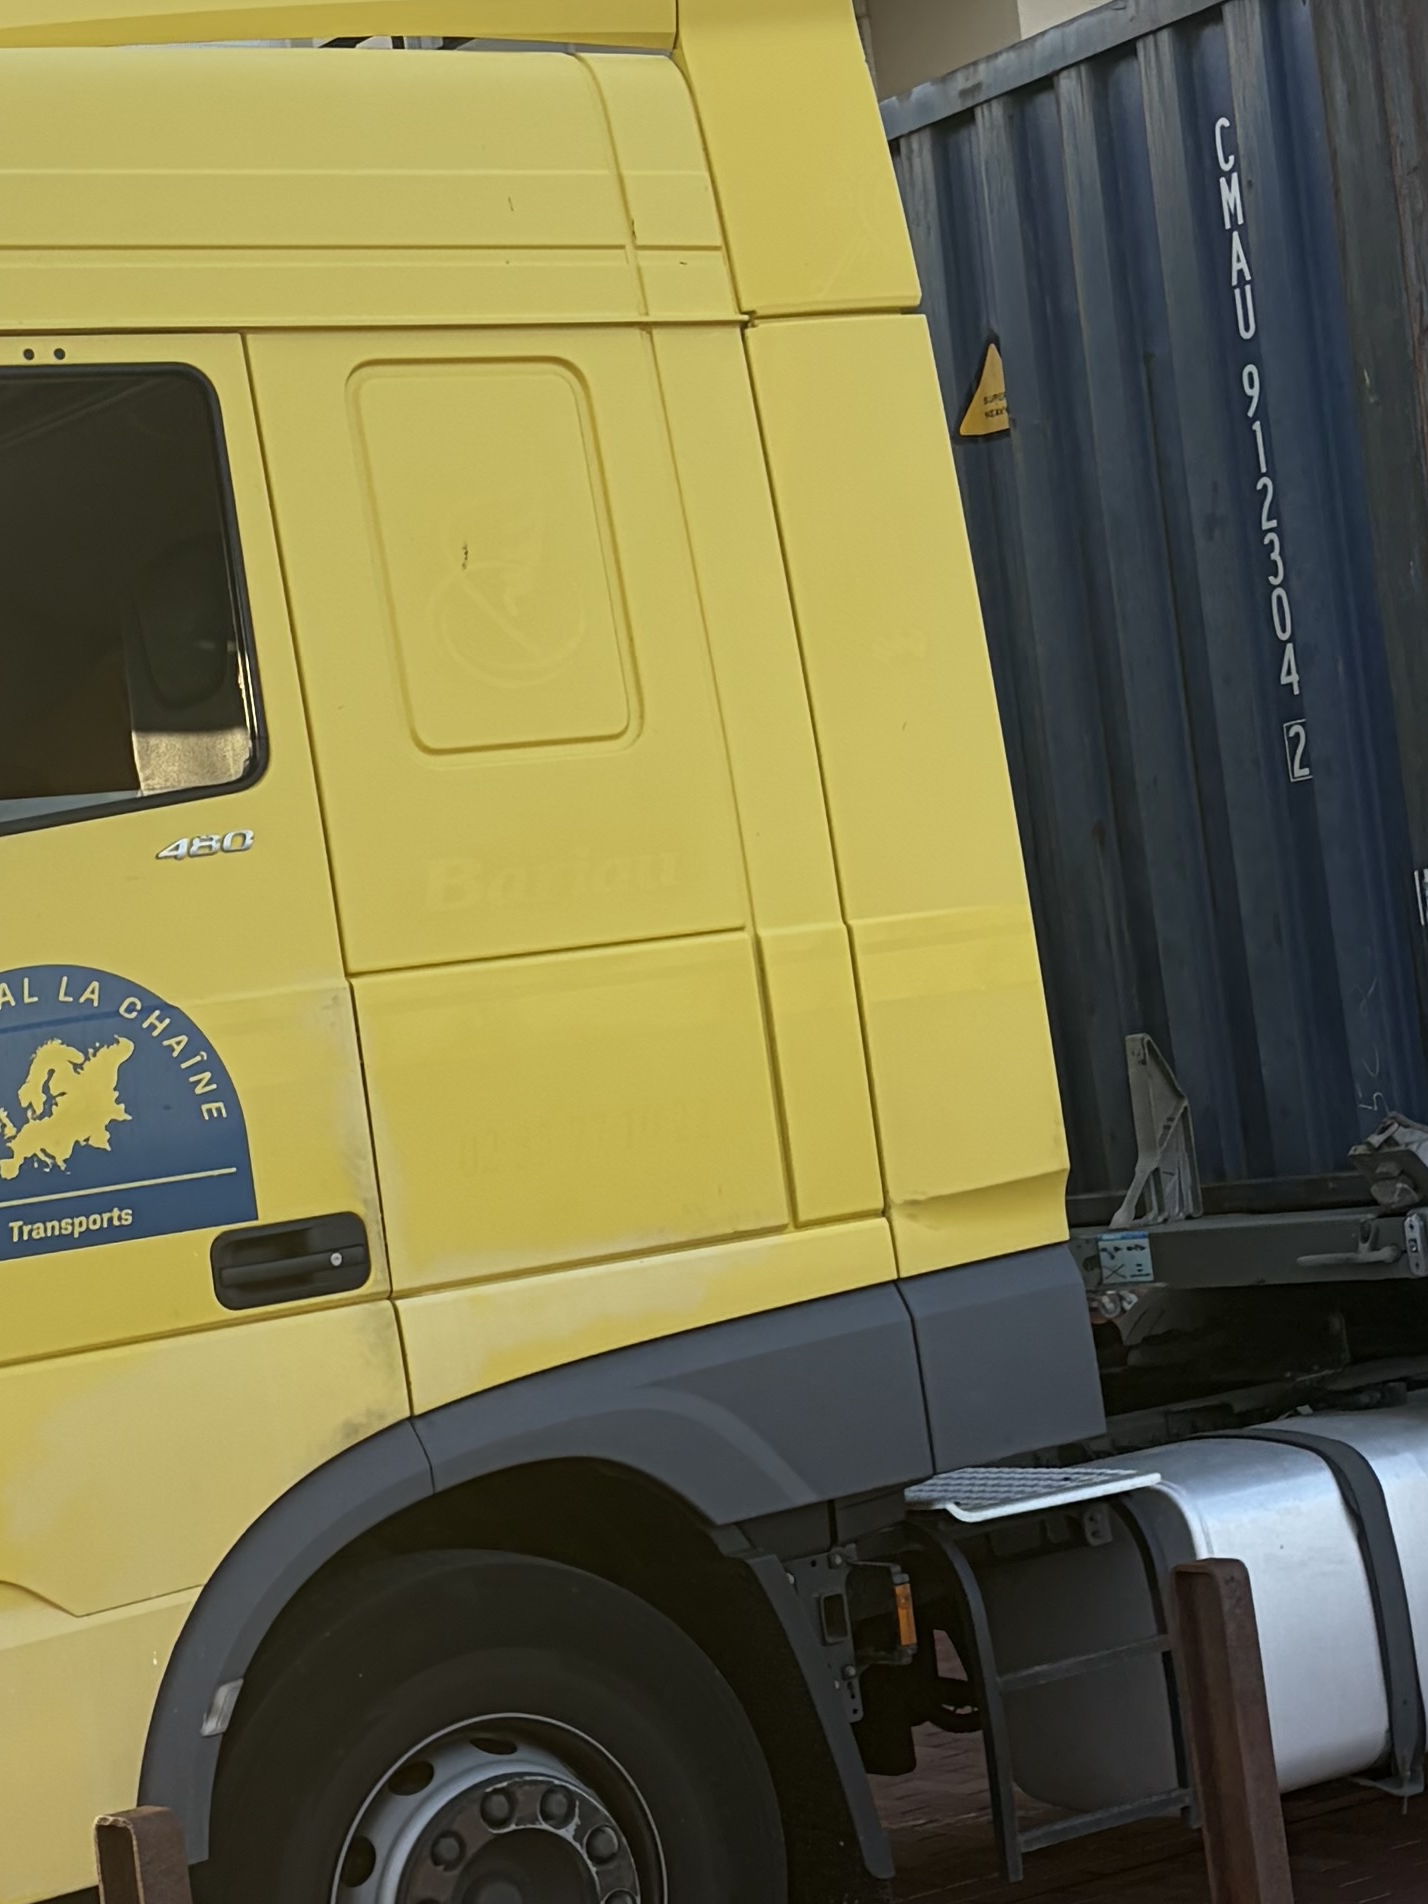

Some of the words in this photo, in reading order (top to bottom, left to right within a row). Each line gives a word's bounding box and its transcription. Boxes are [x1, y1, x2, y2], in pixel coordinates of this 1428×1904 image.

[1214, 116, 1257, 341] CMAU
[1242, 363, 1301, 696] 912304
[1286, 722, 1311, 780] 2
[155, 829, 256, 861] 480
[58, 976, 102, 1008] LA
[120, 997, 229, 1122] CHAÎNE
[9, 1205, 134, 1244] Transports
